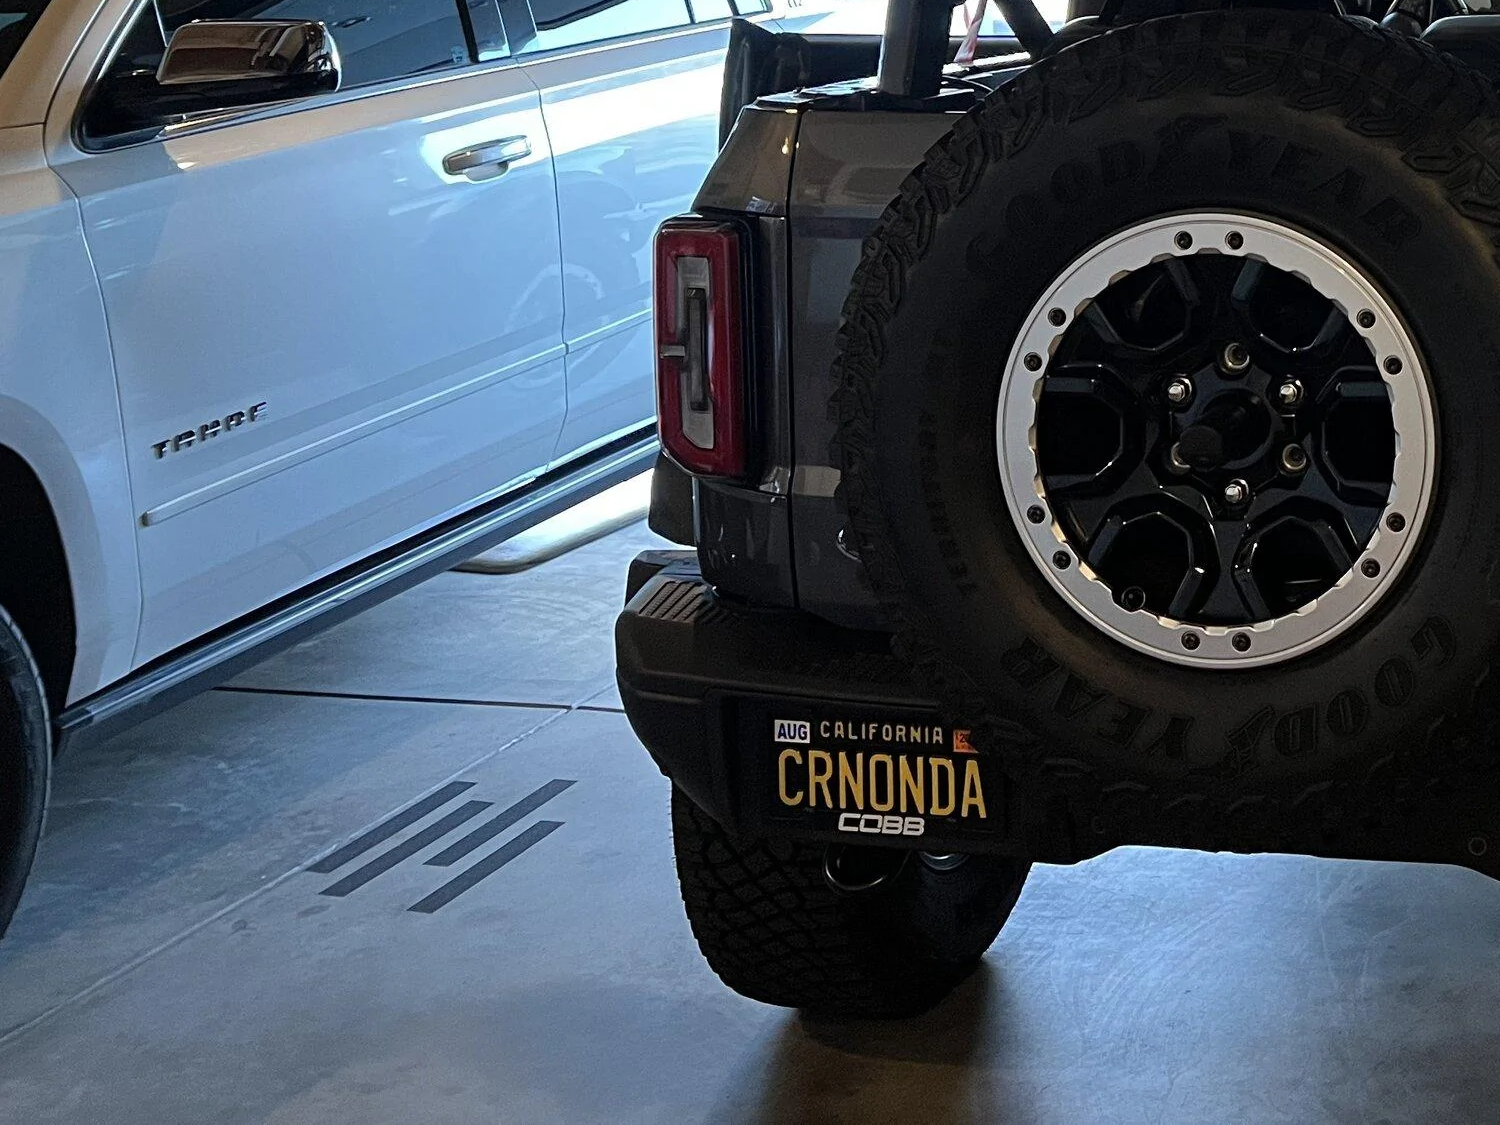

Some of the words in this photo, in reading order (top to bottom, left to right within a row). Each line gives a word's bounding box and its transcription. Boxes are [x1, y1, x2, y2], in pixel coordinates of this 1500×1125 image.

[151, 401, 267, 460] TAHOE
[777, 722, 808, 741] AUG
[820, 721, 943, 745] CALIFORNIA
[778, 748, 987, 819] CRNONDA
[838, 812, 925, 837] COBB
